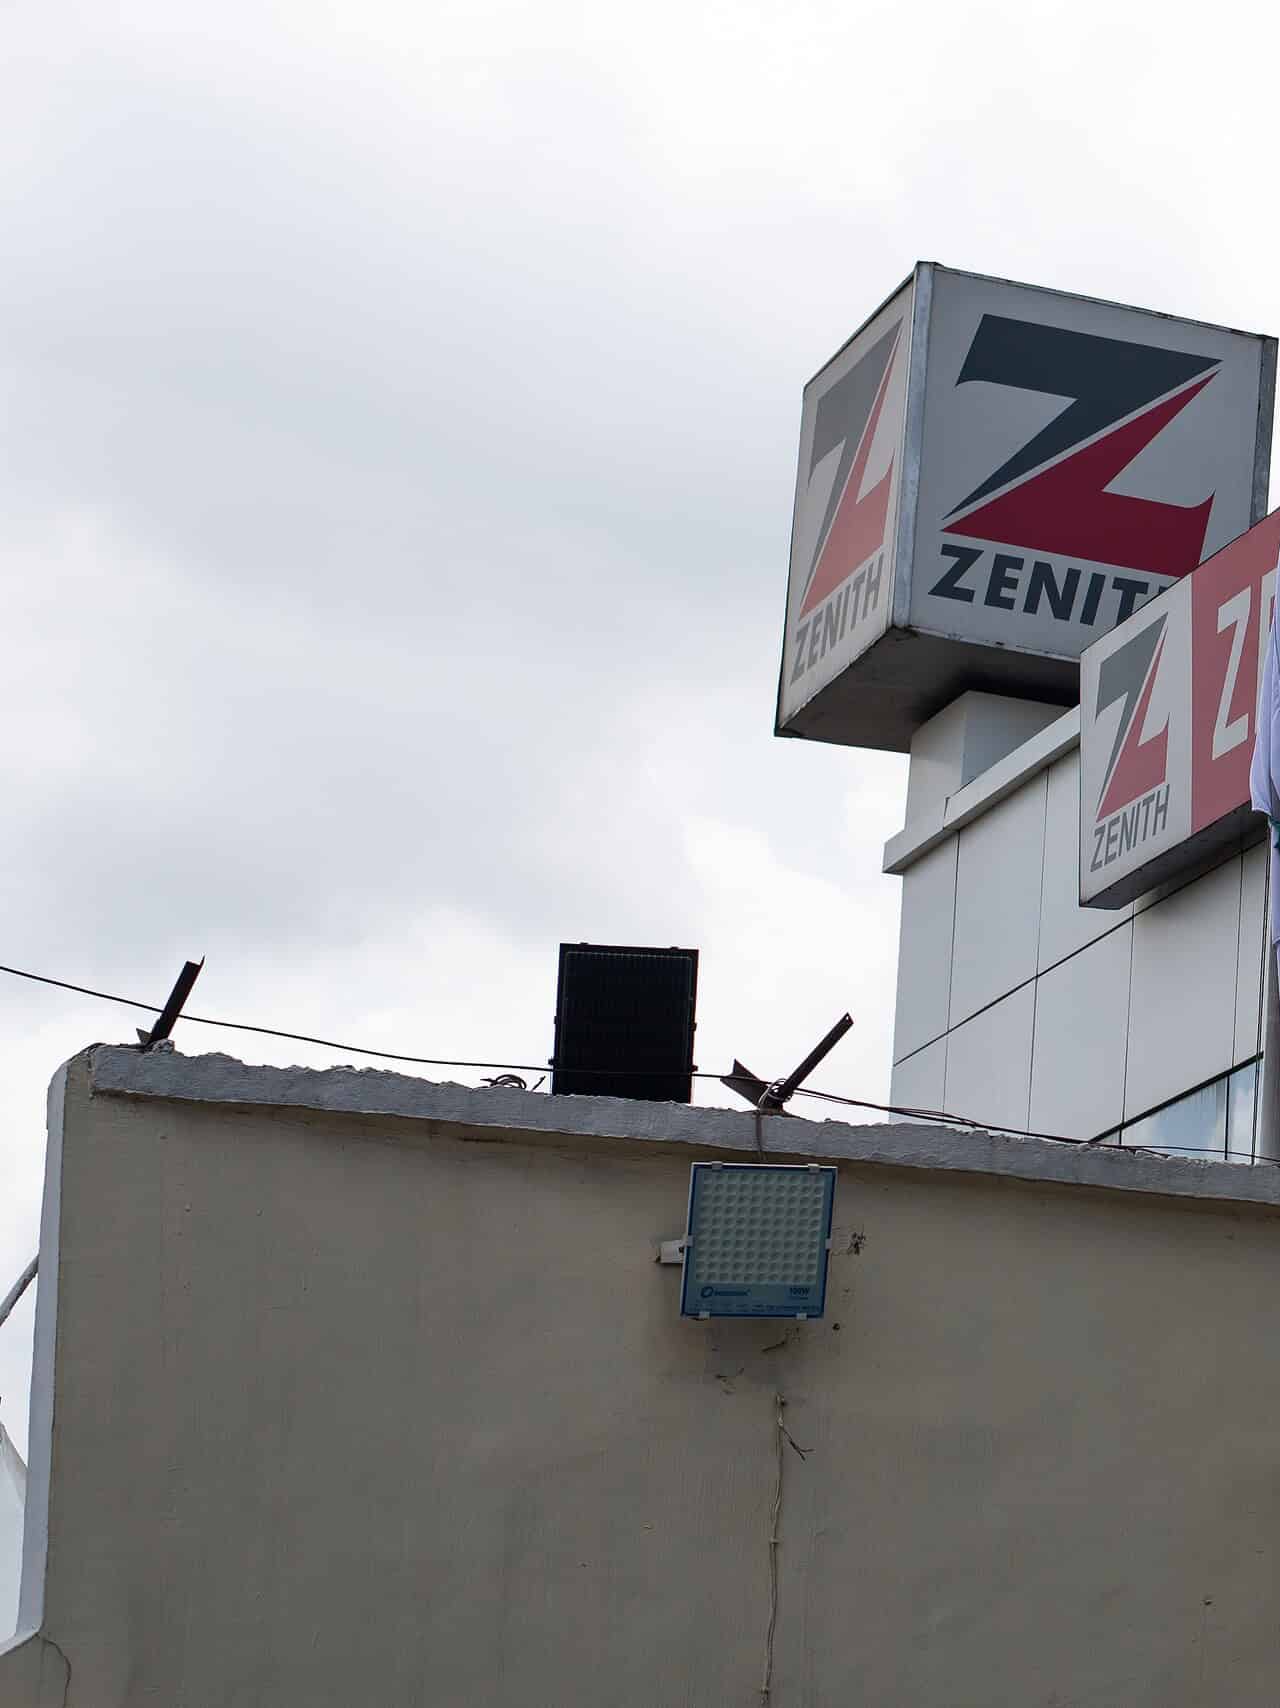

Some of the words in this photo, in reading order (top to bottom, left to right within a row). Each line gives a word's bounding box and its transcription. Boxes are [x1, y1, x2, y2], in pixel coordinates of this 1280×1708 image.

[790, 552, 884, 686] ZENITH
[928, 543, 1169, 627] ZENIT
[1090, 784, 1170, 872] ZENITH
